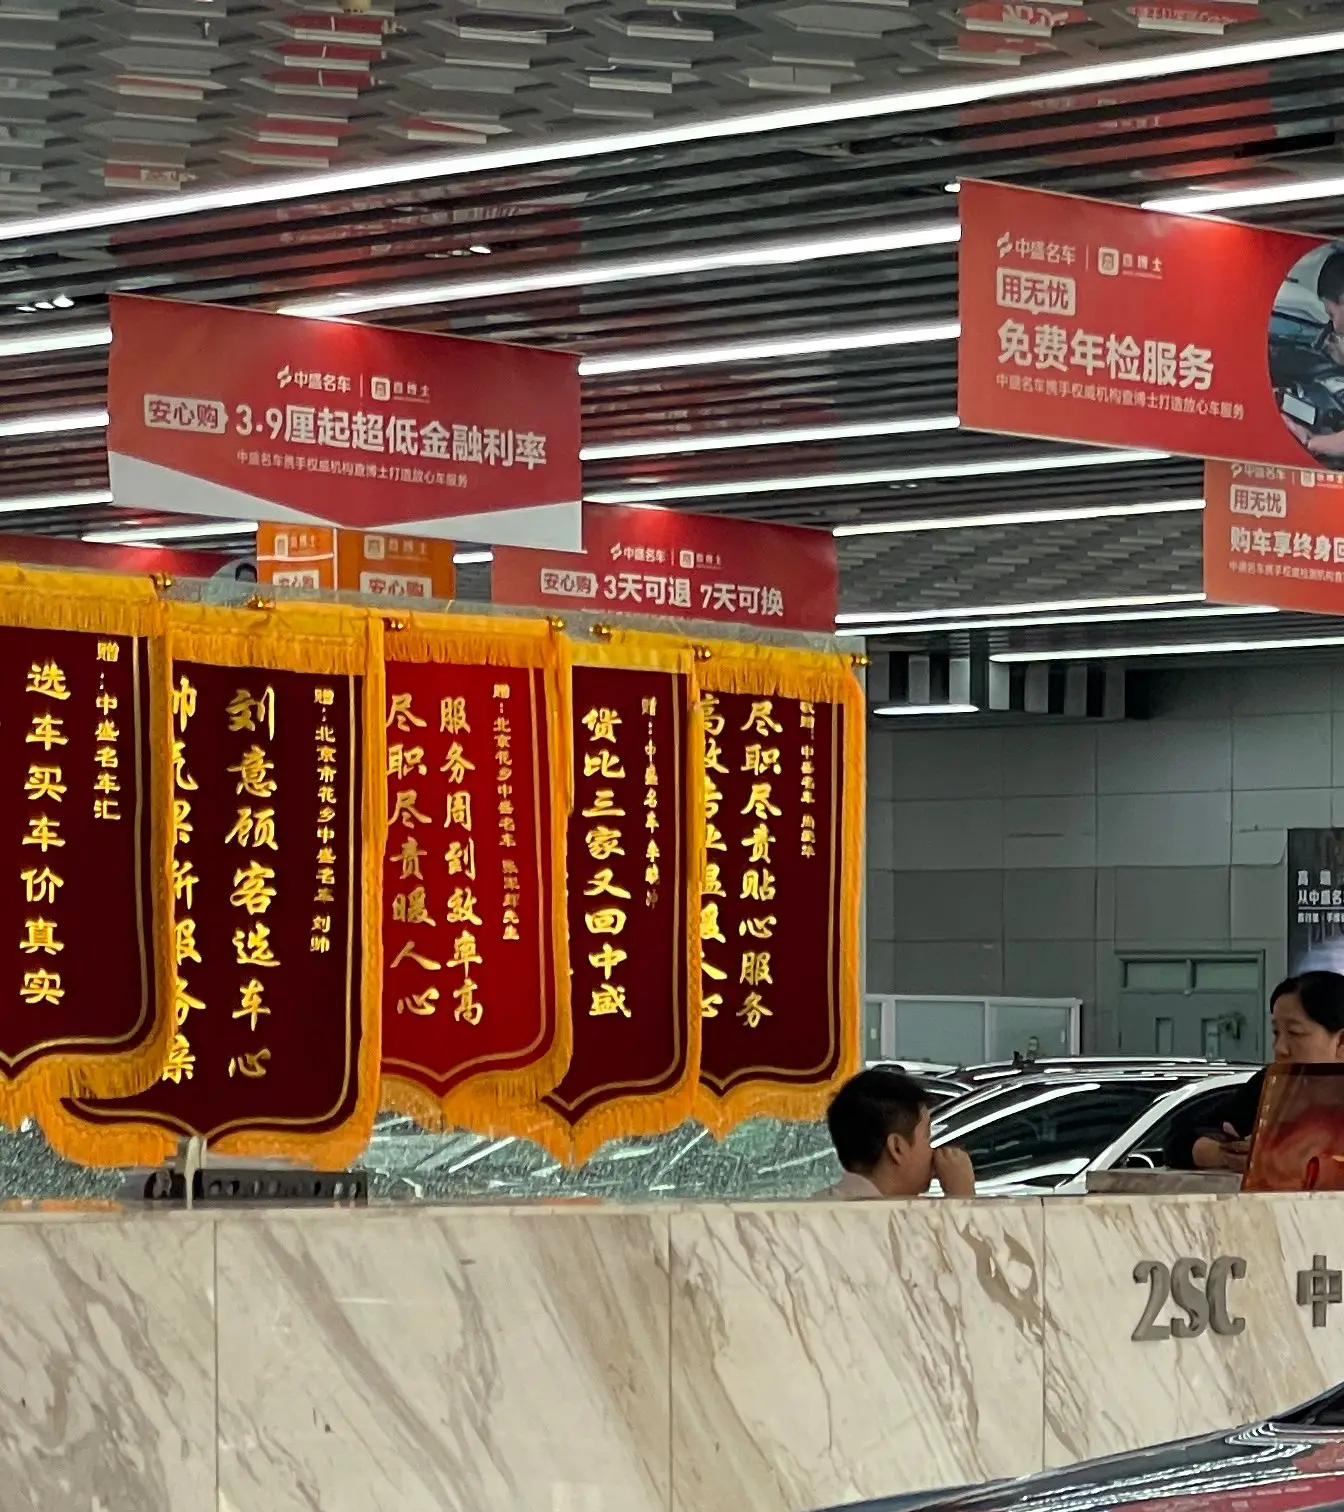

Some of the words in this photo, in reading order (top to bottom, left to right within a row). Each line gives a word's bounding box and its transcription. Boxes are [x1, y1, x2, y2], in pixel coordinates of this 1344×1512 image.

[1015, 237, 1076, 265] 中盛名车
[1002, 274, 1069, 311] 用无忧
[293, 371, 351, 394] 中盛名车
[997, 318, 1214, 391] 免费年检服务
[149, 399, 219, 430] 安心购
[235, 403, 547, 470] 3.9厘起超低金融利率
[1233, 488, 1282, 514] 用无忧
[543, 572, 592, 594] 安心购
[603, 572, 691, 609] 3天可退
[700, 582, 784, 617] 7天可换
[19, 660, 72, 1006] 选车买车价真实
[385, 695, 442, 1018] 尽职尽责暖人心
[439, 696, 484, 1027] 服务周到效率高
[581, 706, 632, 1019] 货比三家又回中盛
[736, 700, 783, 1028] 尽职尽责贴心服务
[1131, 1255, 1248, 1342] 2SC
